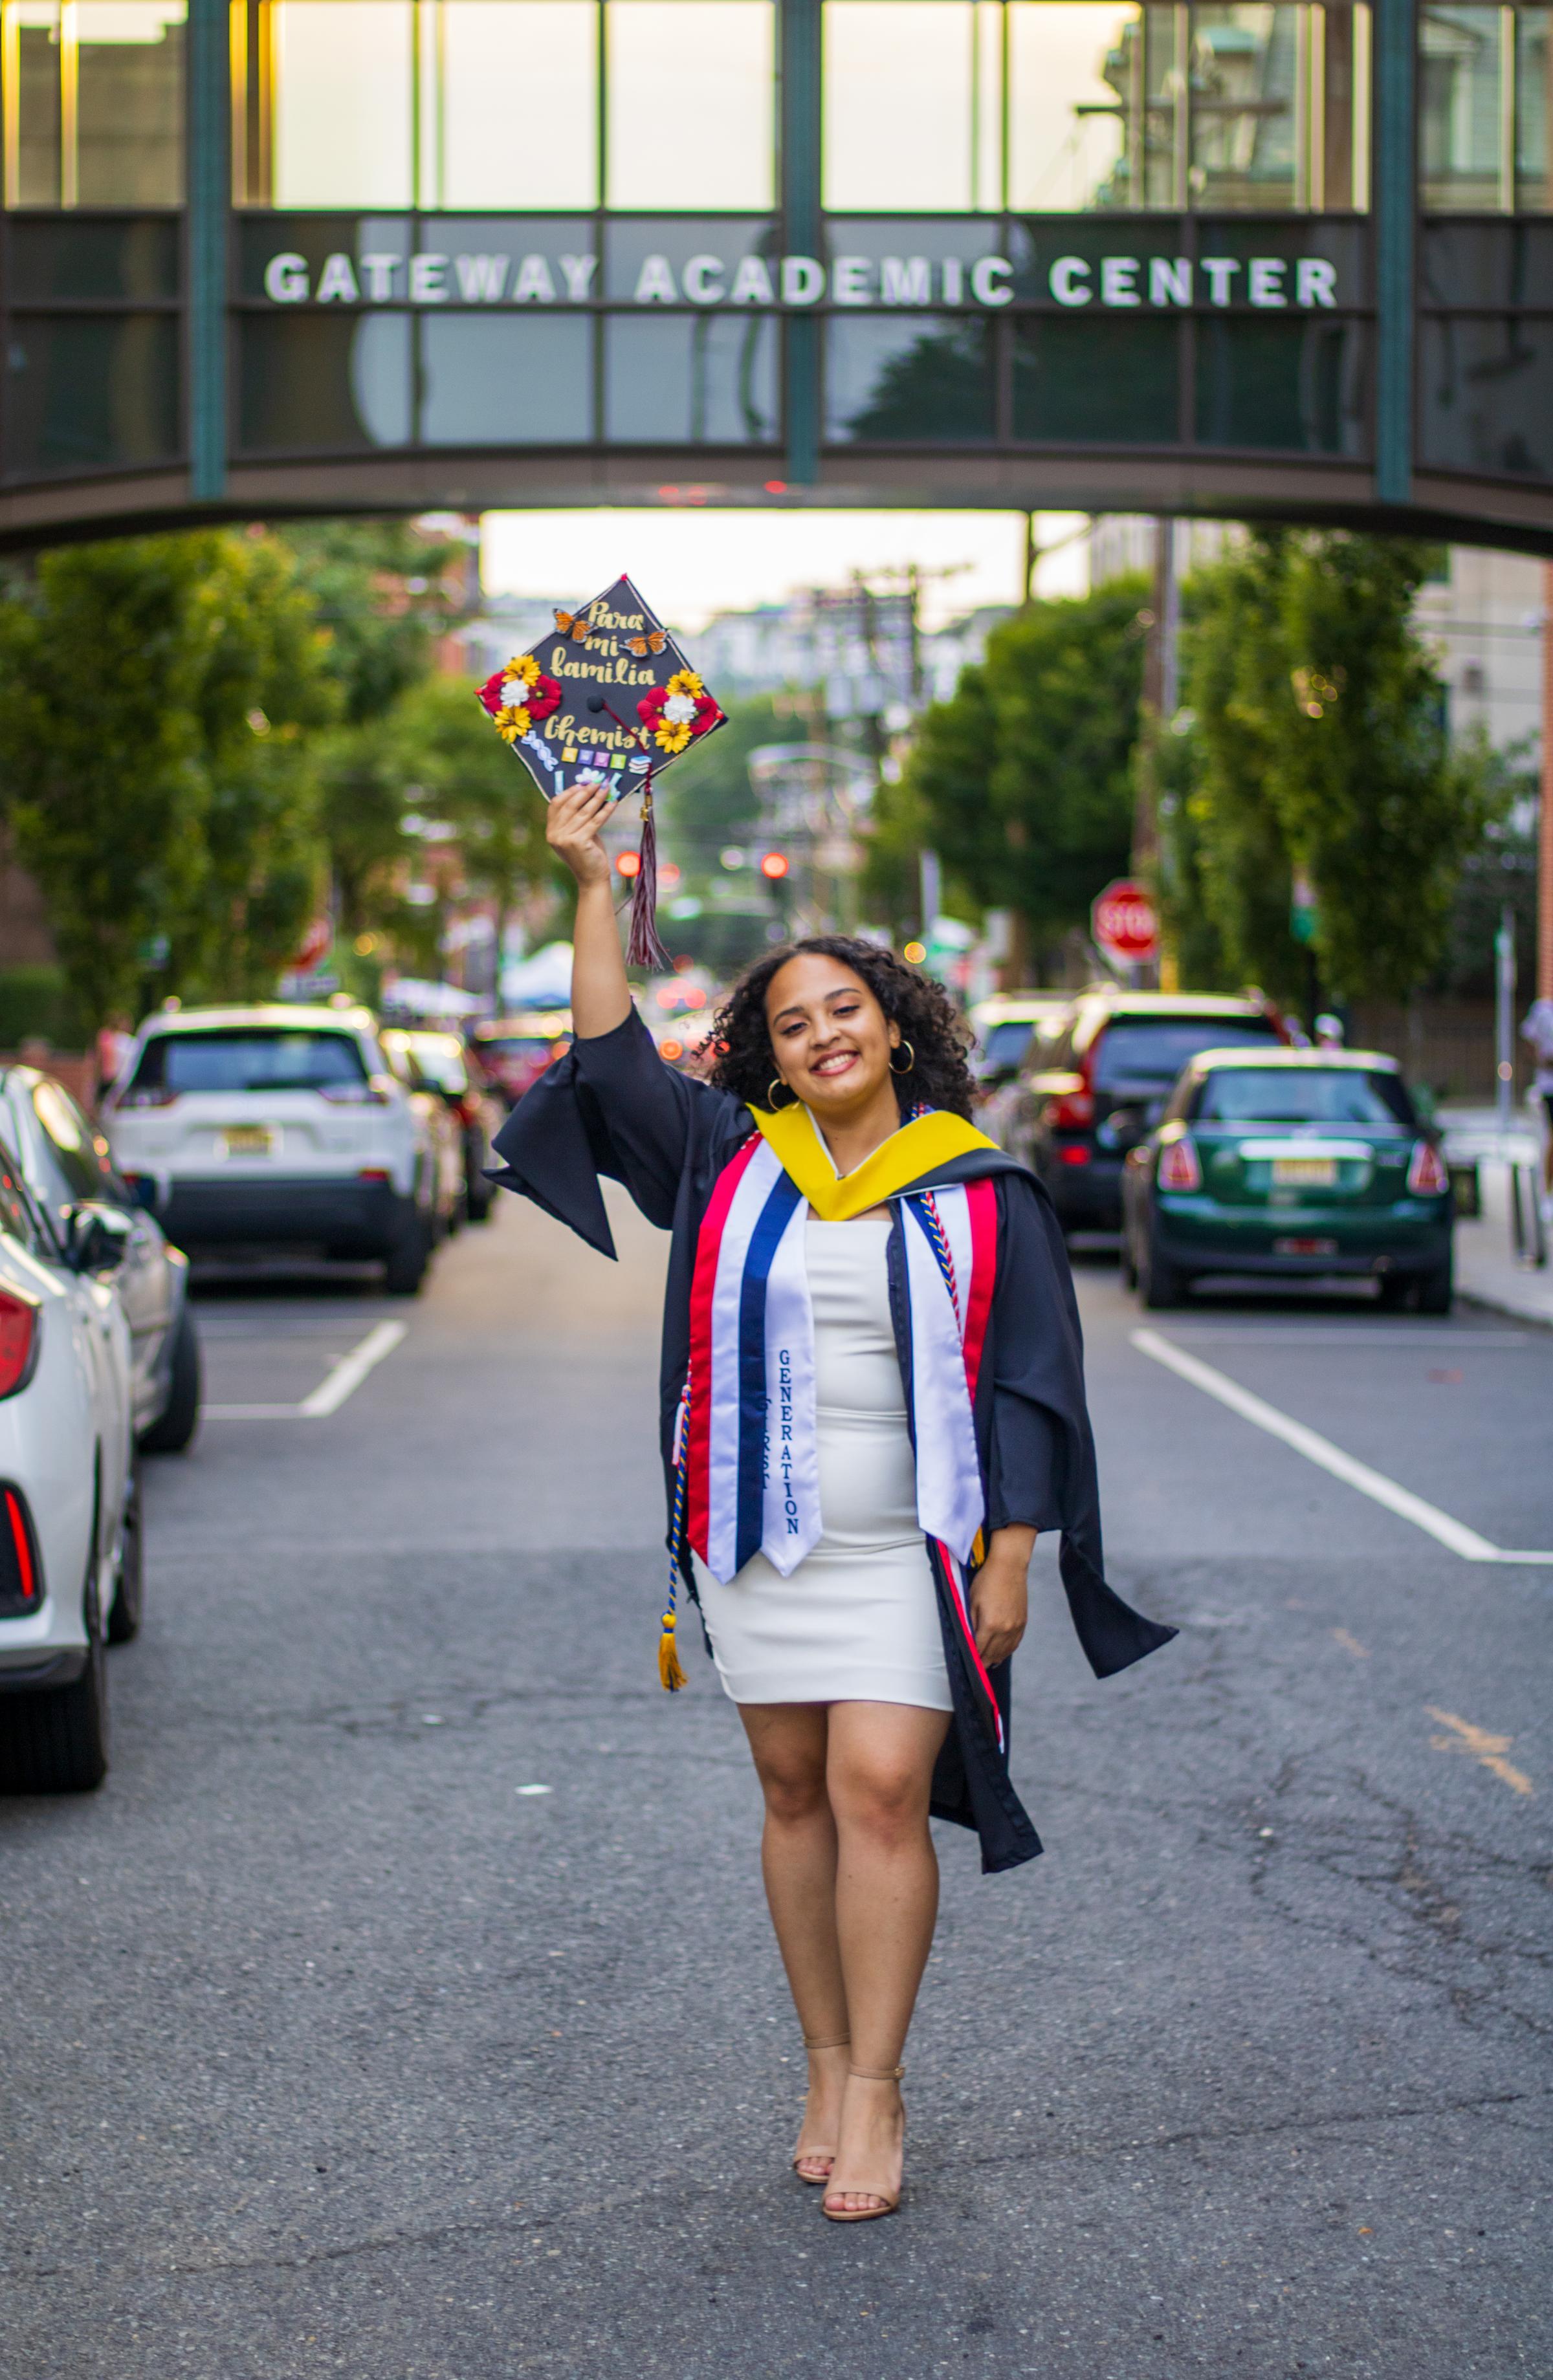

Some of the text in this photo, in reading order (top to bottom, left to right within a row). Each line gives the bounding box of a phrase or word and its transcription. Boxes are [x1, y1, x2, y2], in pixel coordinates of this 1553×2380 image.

[265, 252, 1336, 307] GATEWAY ACADEMIC CENTER
[589, 602, 643, 631] Para
[584, 635, 619, 657] mi
[550, 647, 655, 685] familia
[545, 715, 650, 750] Chemist
[779, 1349, 799, 1534] GENERATION
